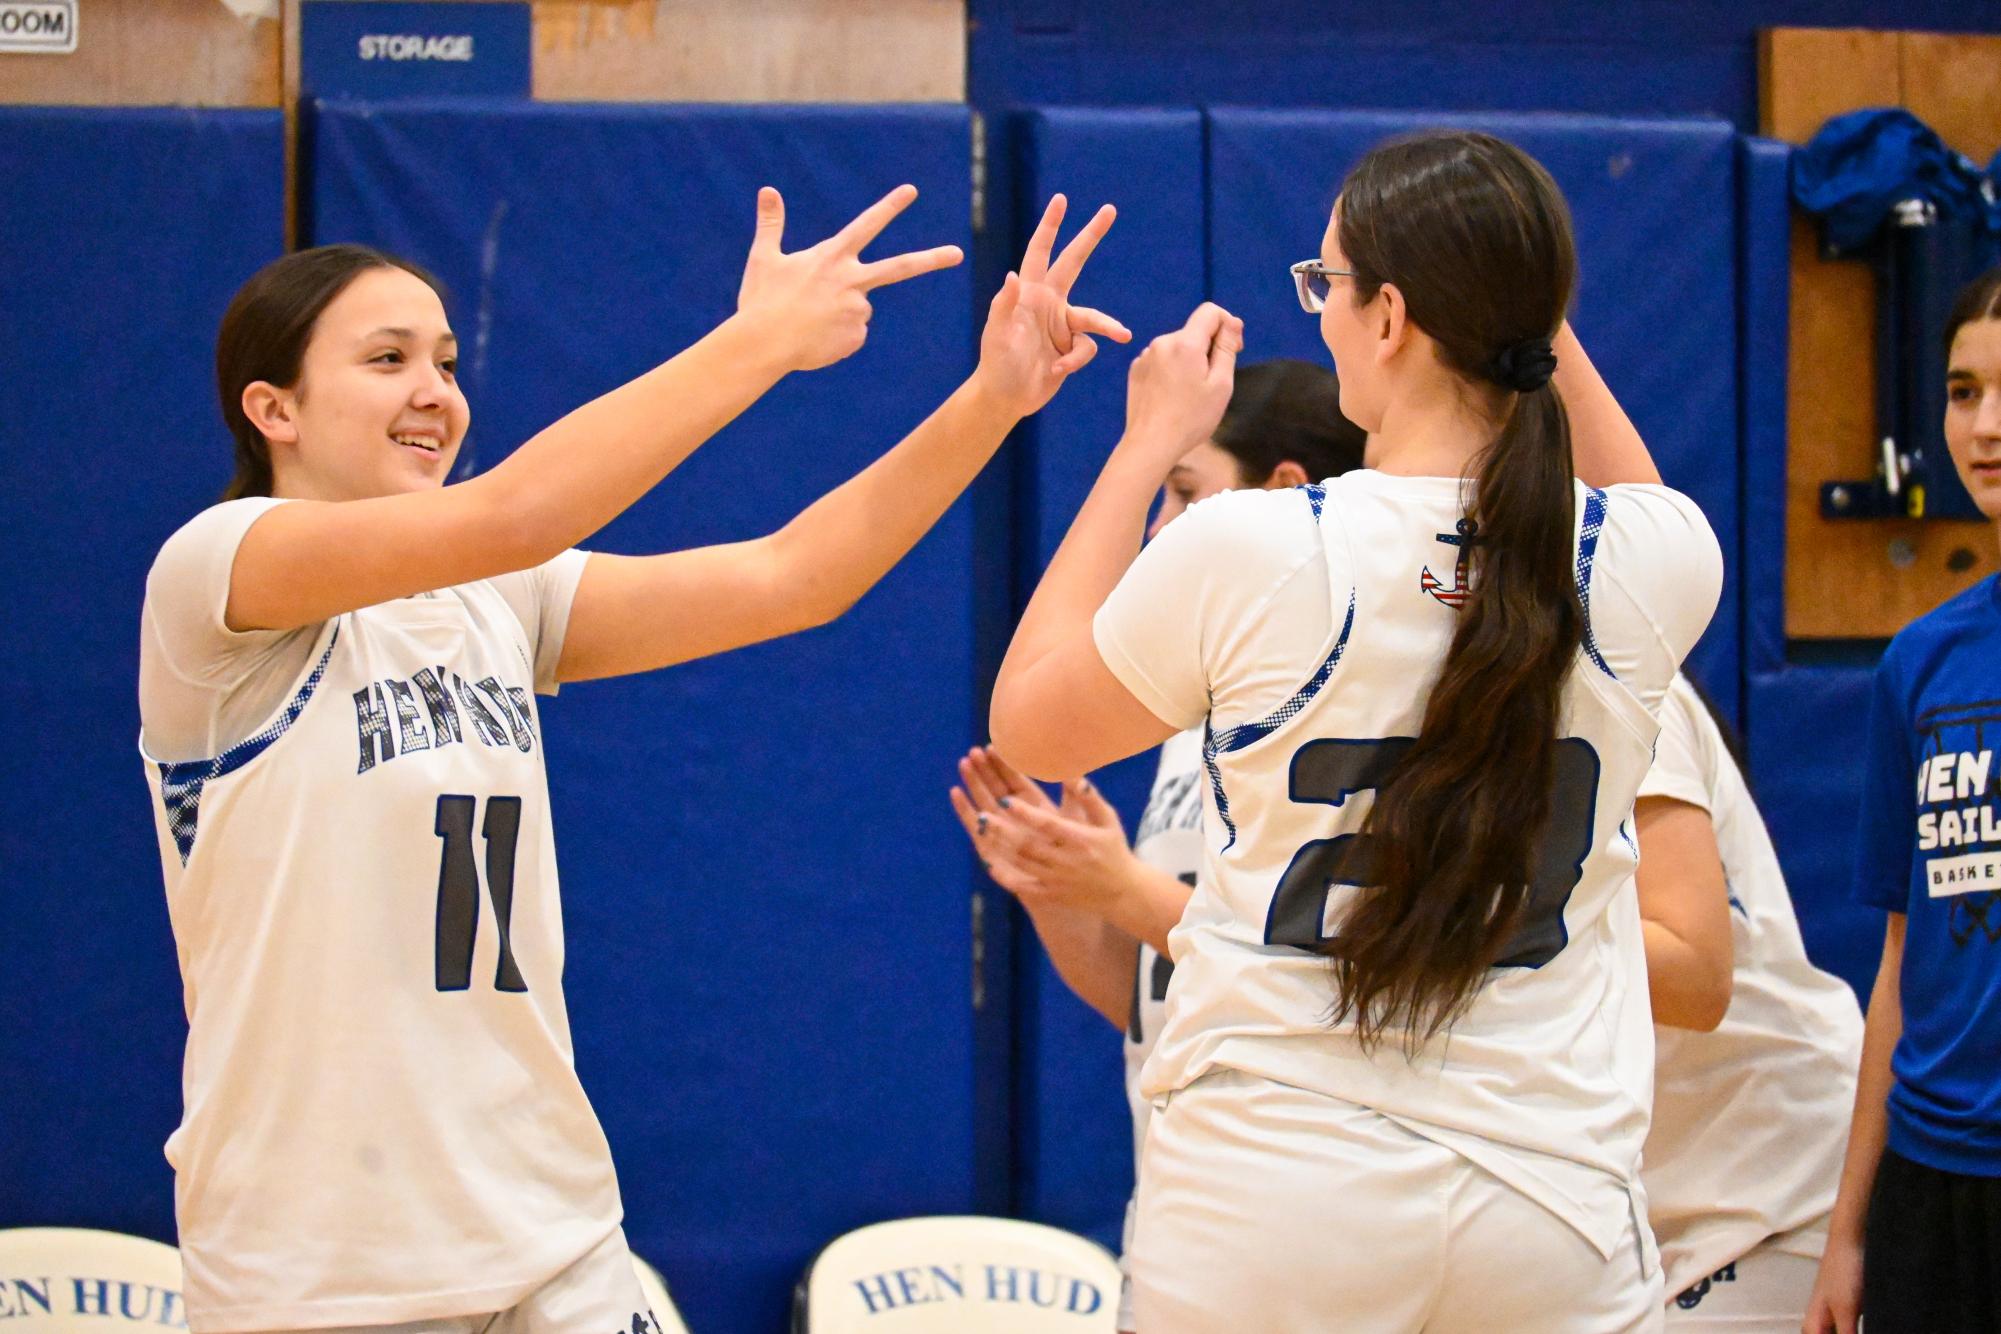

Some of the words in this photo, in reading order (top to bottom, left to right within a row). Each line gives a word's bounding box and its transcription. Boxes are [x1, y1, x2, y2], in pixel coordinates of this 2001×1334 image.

[359, 34, 473, 61] STORAGE
[434, 793, 529, 992] 11
[1933, 863, 2001, 885] BASKE
[853, 1265, 965, 1315] HEN
[983, 1264, 1103, 1316] HUD
